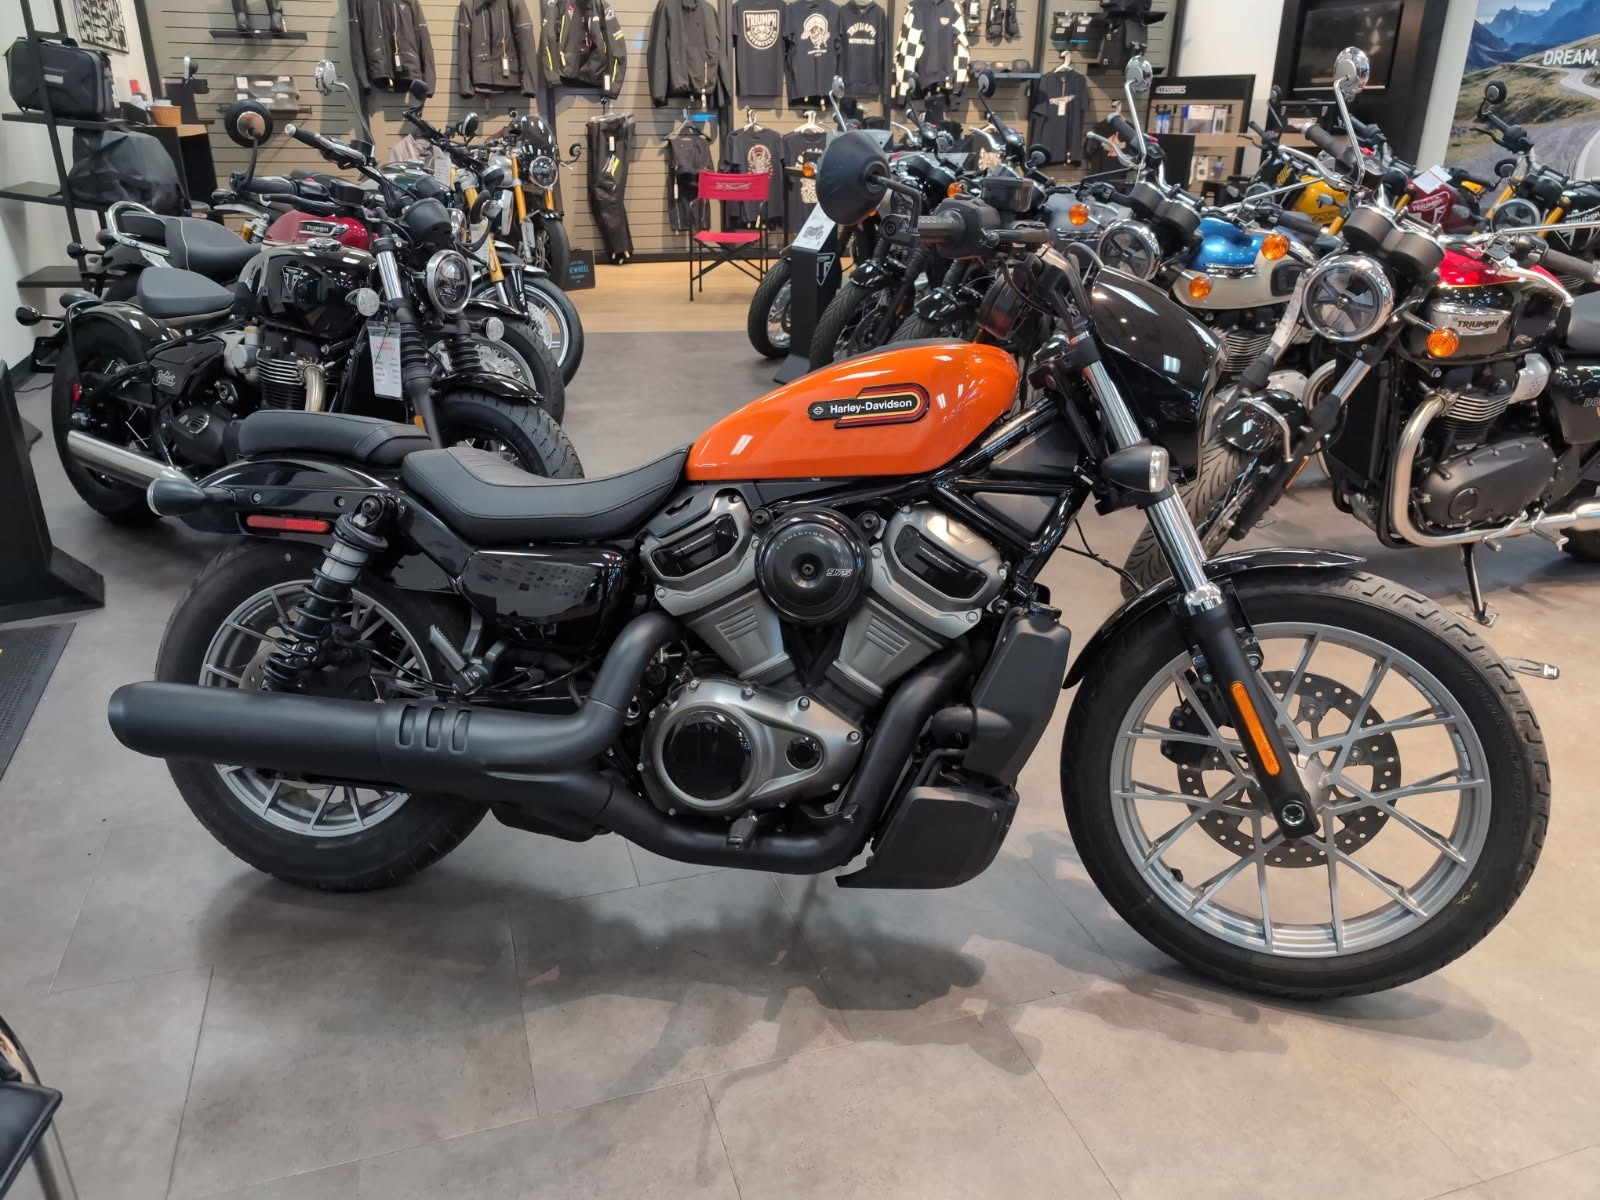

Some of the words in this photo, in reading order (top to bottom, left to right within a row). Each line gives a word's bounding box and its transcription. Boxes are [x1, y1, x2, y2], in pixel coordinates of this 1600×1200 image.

[745, 13, 777, 28] TRIUMPH
[1543, 49, 1599, 66] DREAM,
[1457, 320, 1499, 329] TRIUMPH
[830, 399, 913, 414] Harley-Davidson
[826, 568, 853, 577] 975
